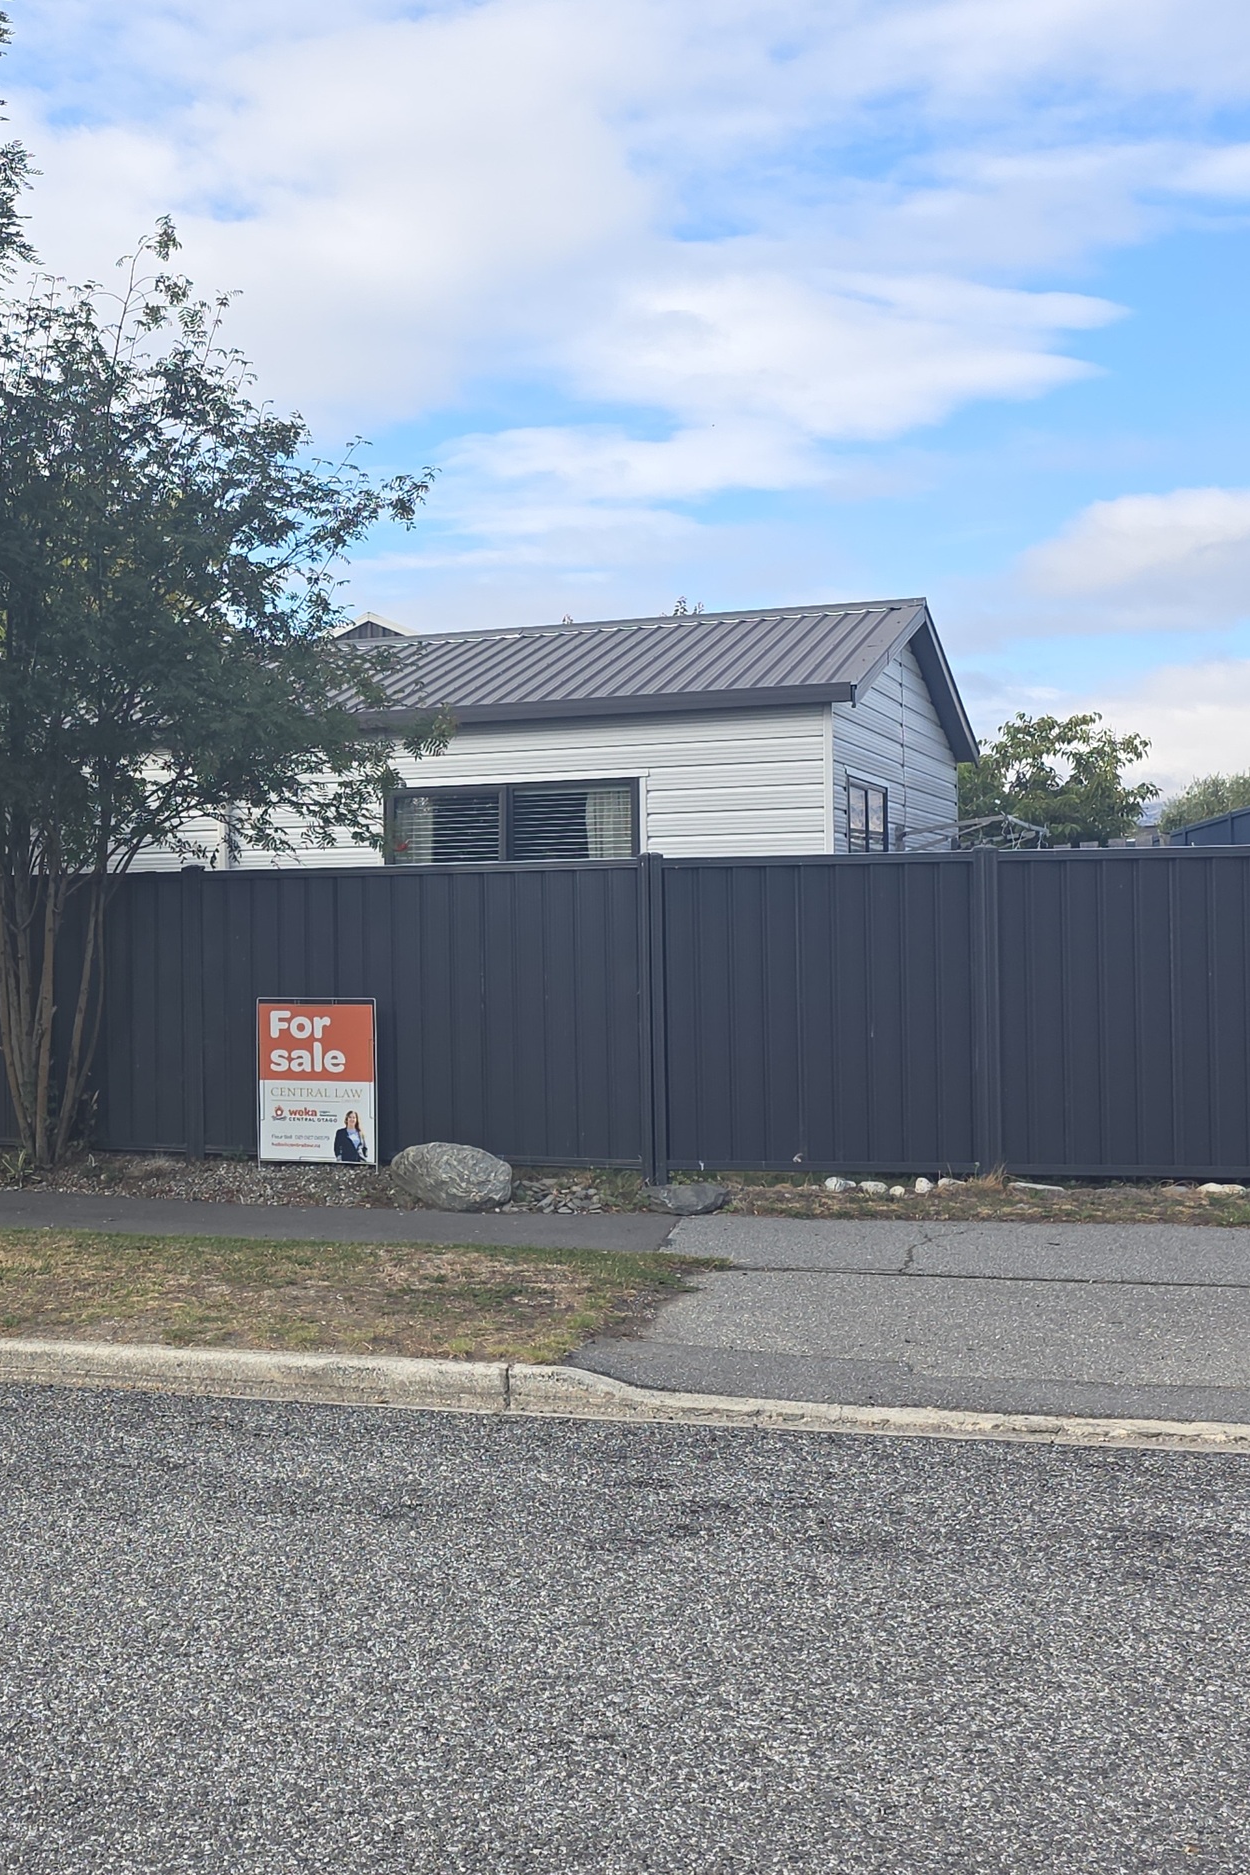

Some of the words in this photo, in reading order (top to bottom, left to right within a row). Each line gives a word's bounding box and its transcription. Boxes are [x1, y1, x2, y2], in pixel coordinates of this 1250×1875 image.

[270, 1010, 331, 1039] For
[270, 1041, 346, 1073] sale
[270, 1087, 330, 1098] CENTRAL
[335, 1088, 363, 1098] LAW
